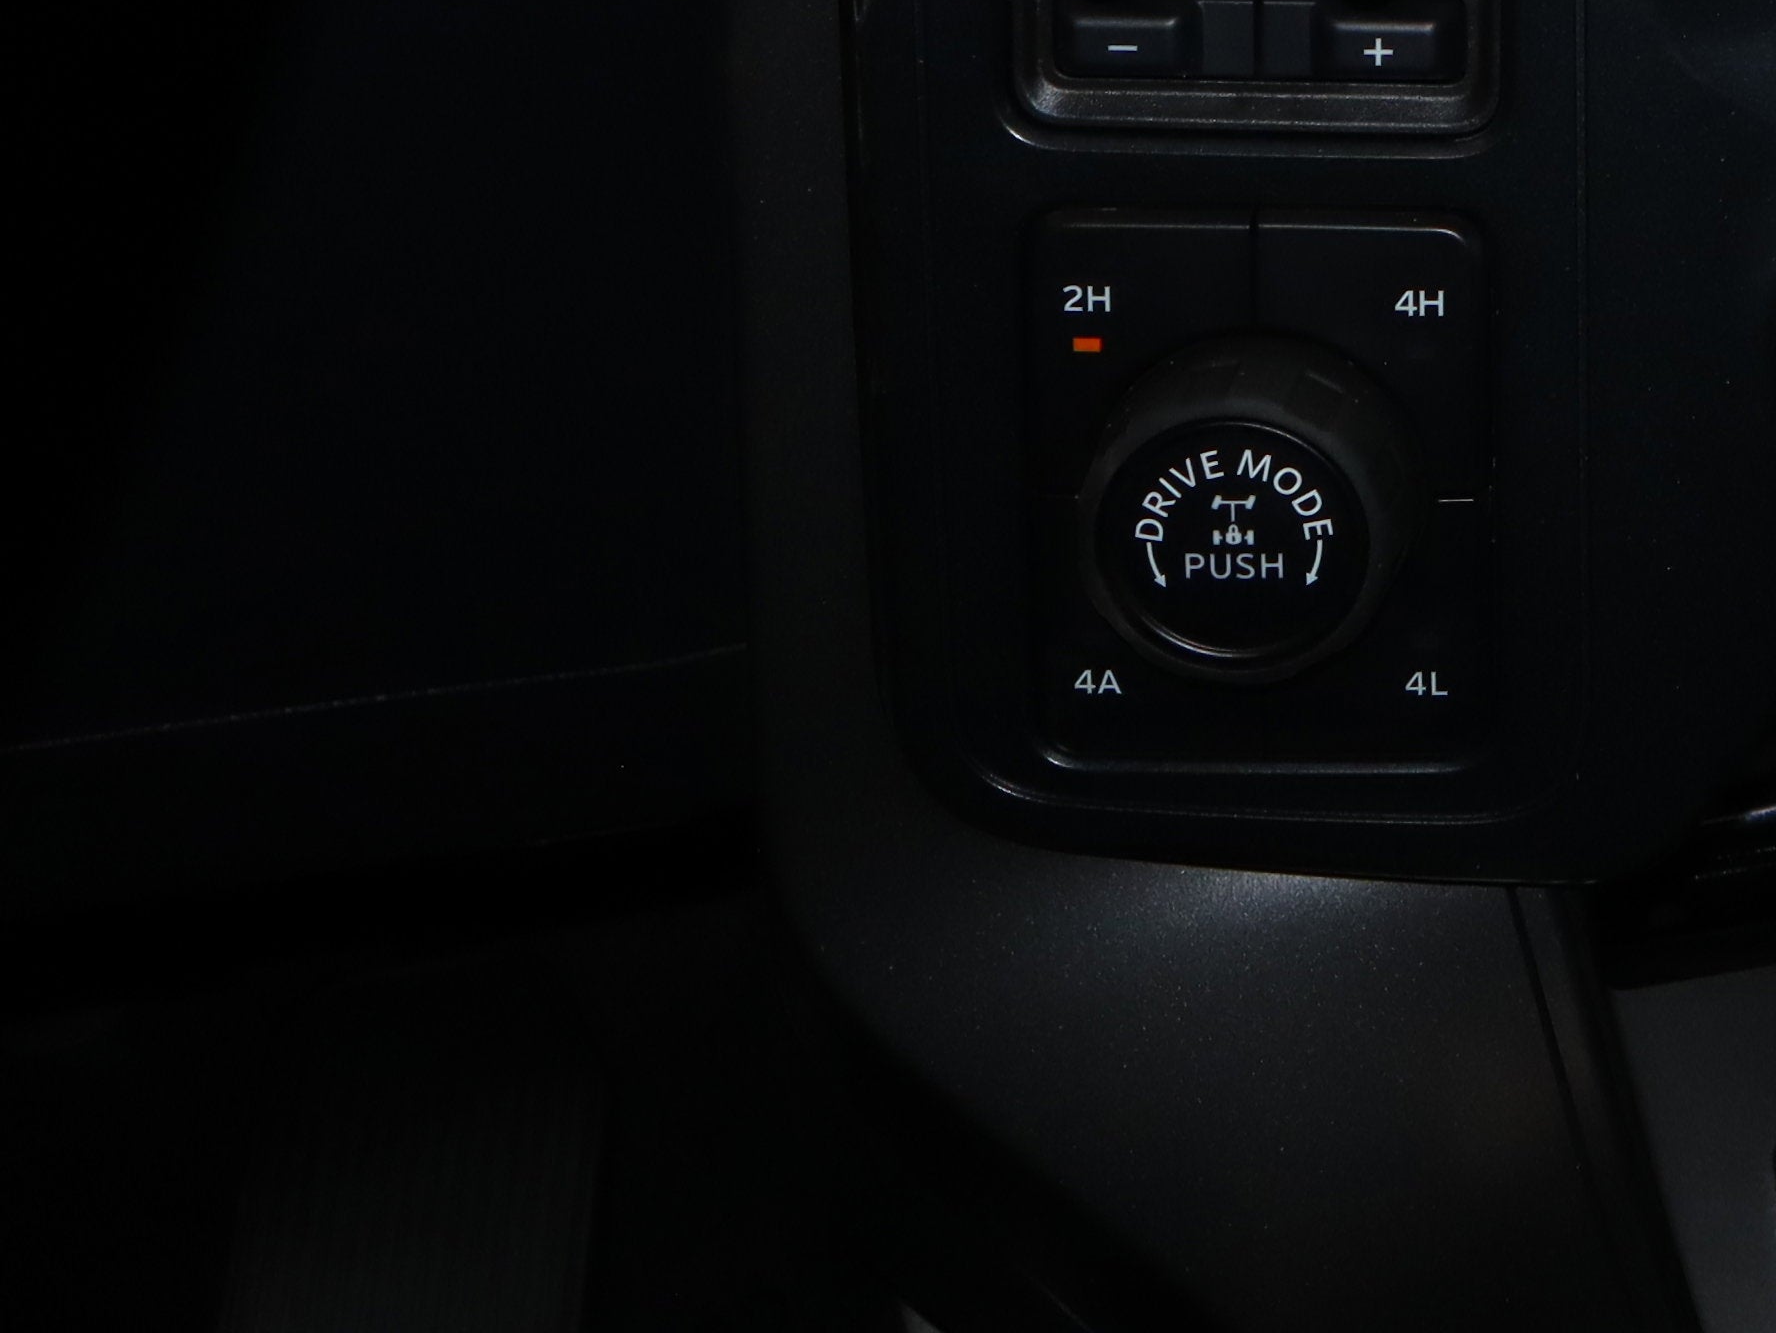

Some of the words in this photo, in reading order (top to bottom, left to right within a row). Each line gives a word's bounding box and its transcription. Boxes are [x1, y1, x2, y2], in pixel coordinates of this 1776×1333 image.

[1062, 285, 1112, 313] 2H
[1394, 290, 1445, 317] 4H
[1135, 450, 1225, 544] DRIVE
[1237, 448, 1334, 541] MODE
[1184, 552, 1285, 580] PUSH
[1073, 669, 1122, 695] 4A
[1404, 671, 1449, 696] 4L
